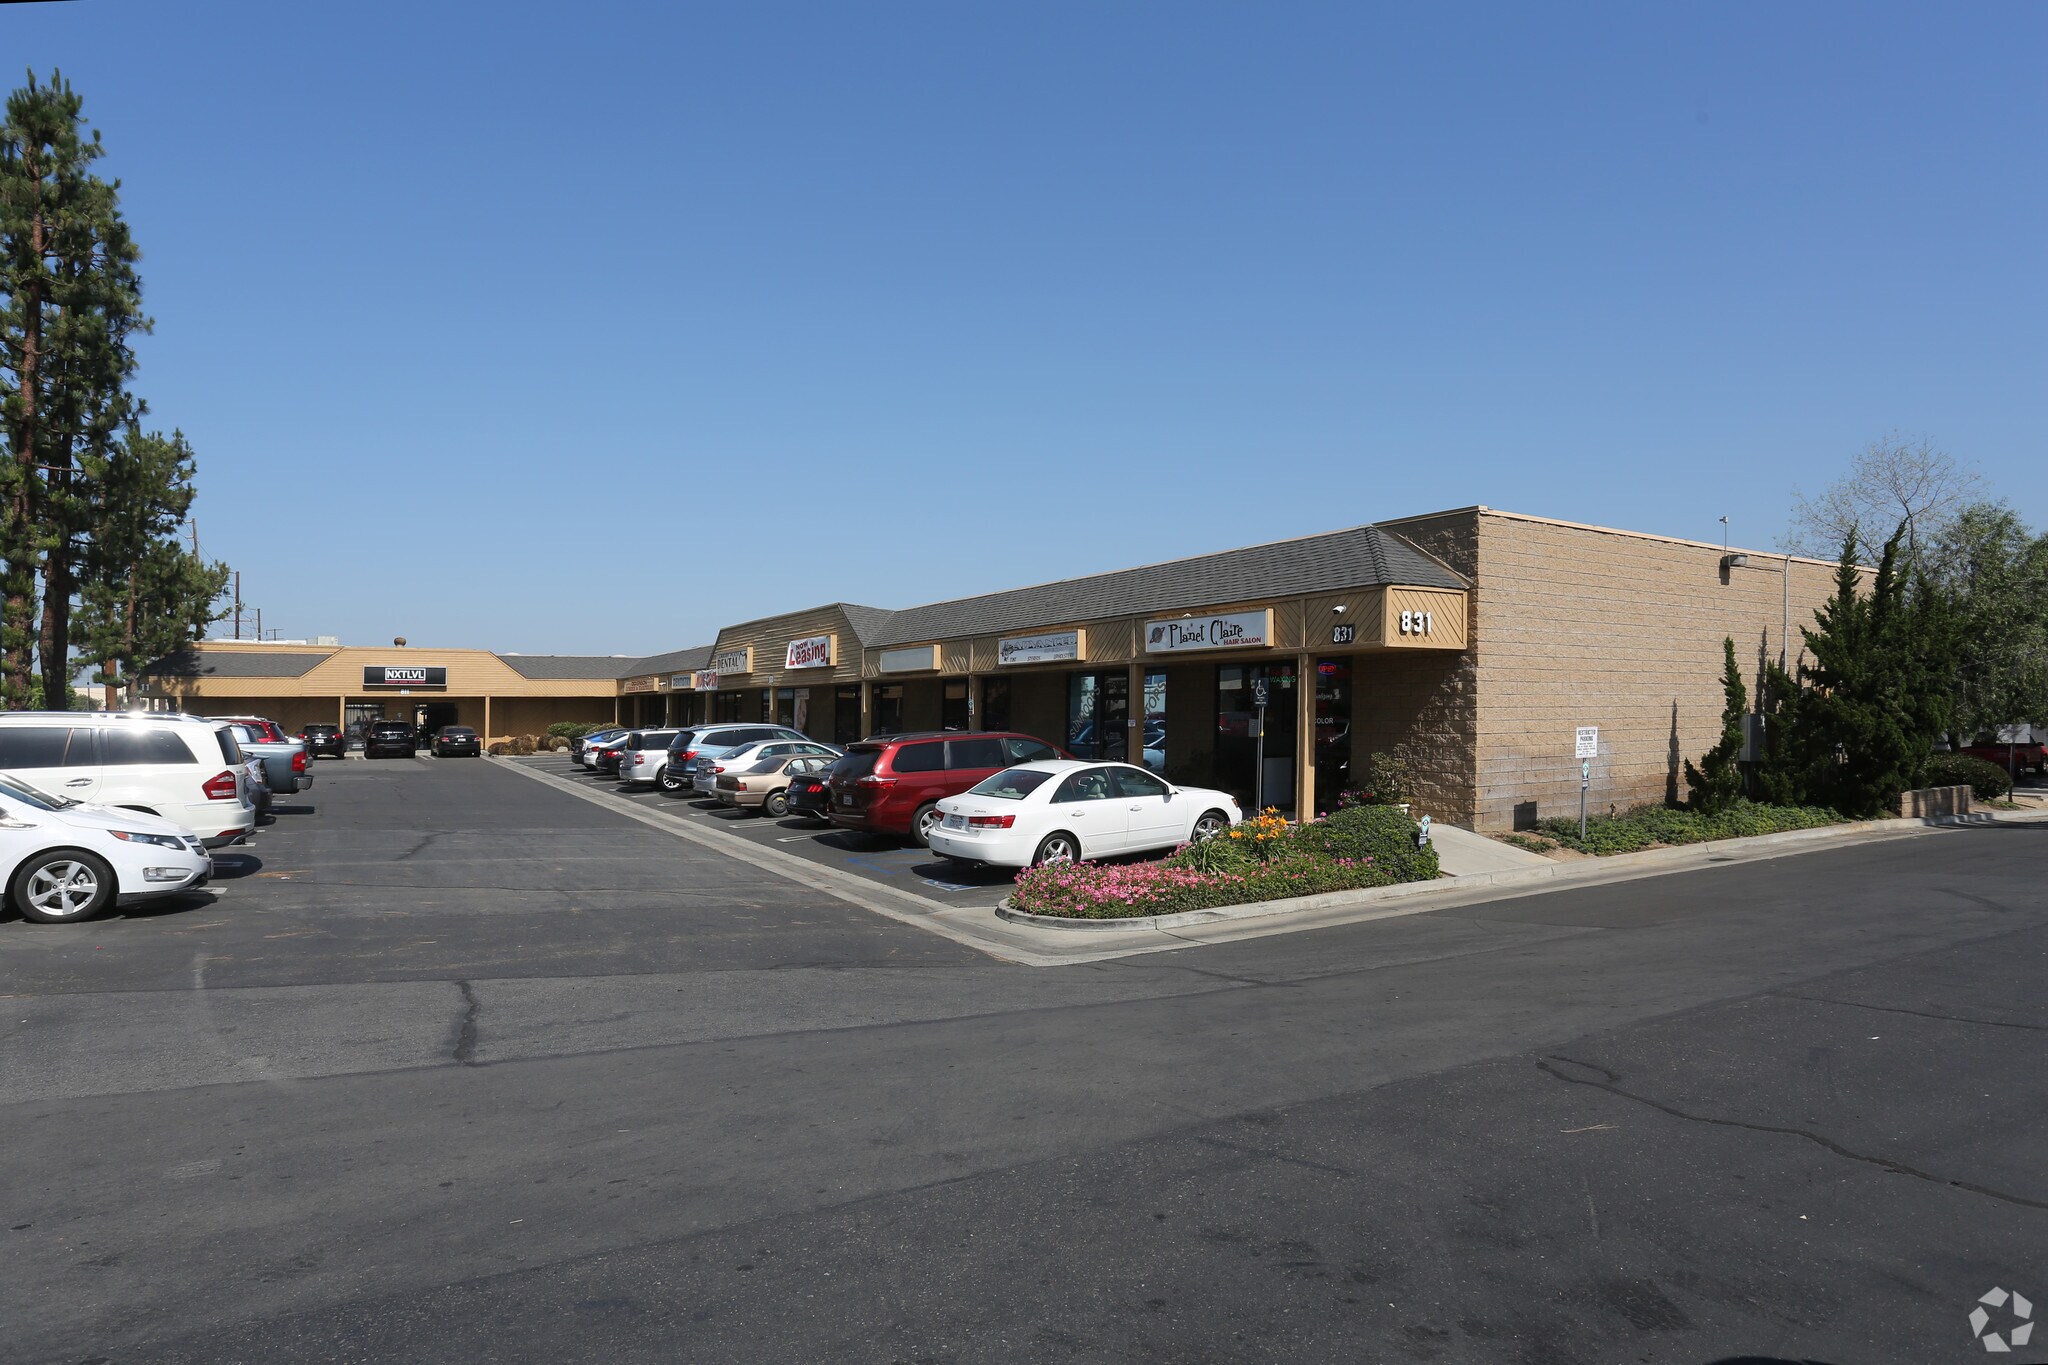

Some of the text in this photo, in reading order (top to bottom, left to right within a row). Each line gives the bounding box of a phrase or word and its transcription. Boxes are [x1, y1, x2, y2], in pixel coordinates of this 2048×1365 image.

[1401, 610, 1433, 633] 831
[1168, 619, 1244, 648] Planet Claire
[1240, 636, 1262, 645] SALON
[1333, 626, 1353, 642] 831
[795, 641, 809, 651] NOW
[789, 642, 826, 667] Leasing
[717, 655, 739, 670] DENTAL
[387, 670, 424, 679] NXTLVL
[1270, 675, 1297, 683] WAXING
